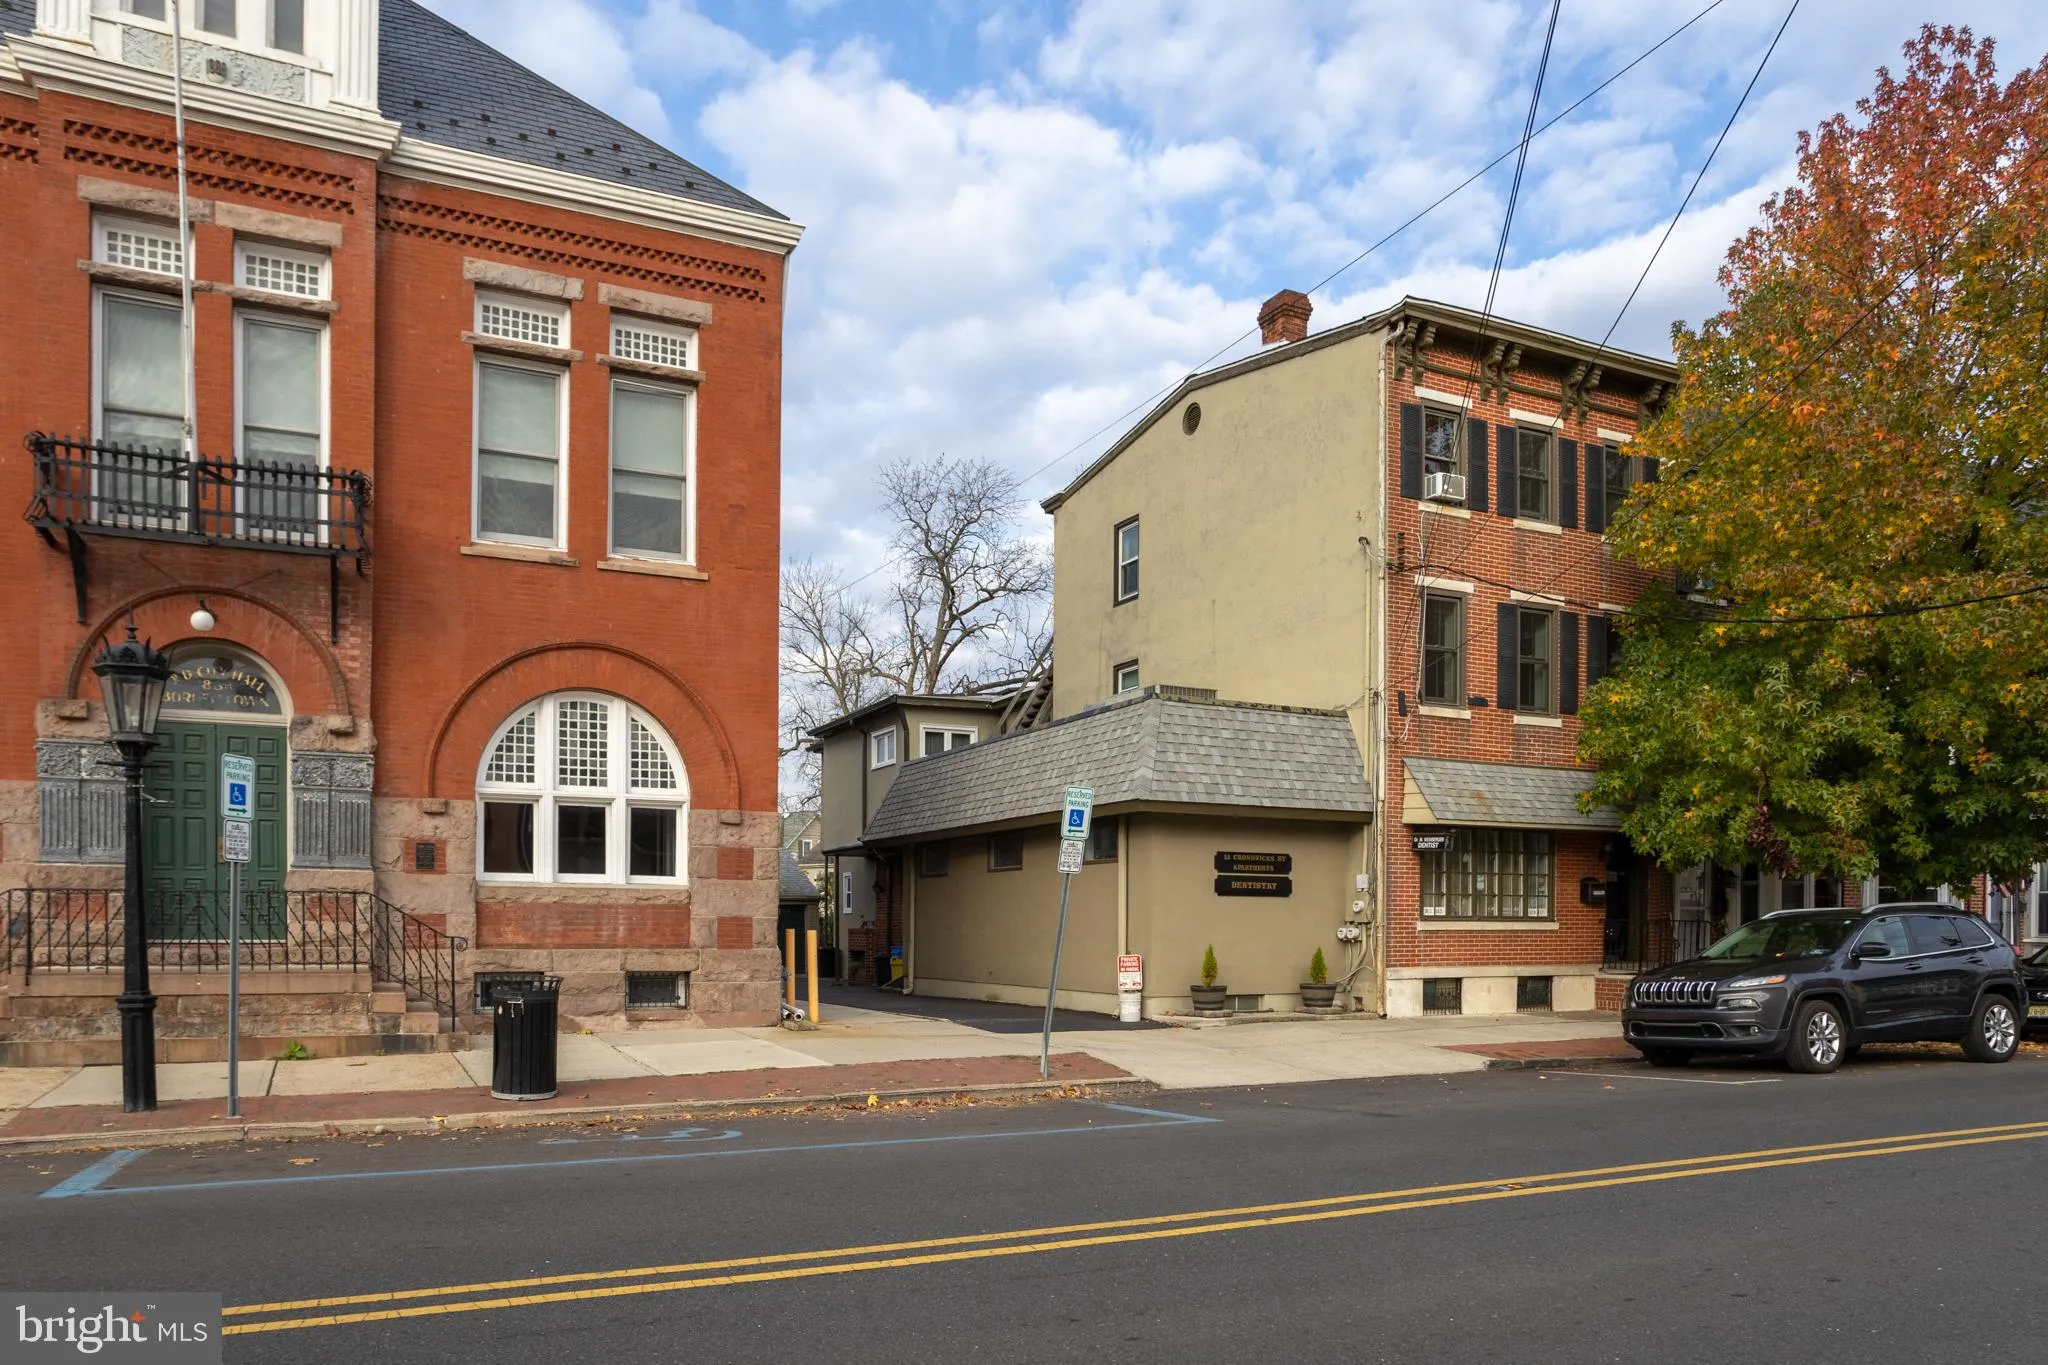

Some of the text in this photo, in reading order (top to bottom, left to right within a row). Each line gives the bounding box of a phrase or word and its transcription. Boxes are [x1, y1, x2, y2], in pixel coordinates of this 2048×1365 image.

[1068, 799, 1089, 809] PARKING
[1232, 864, 1275, 872] APARTMENTS
[1231, 881, 1277, 890] DENTISTRY
